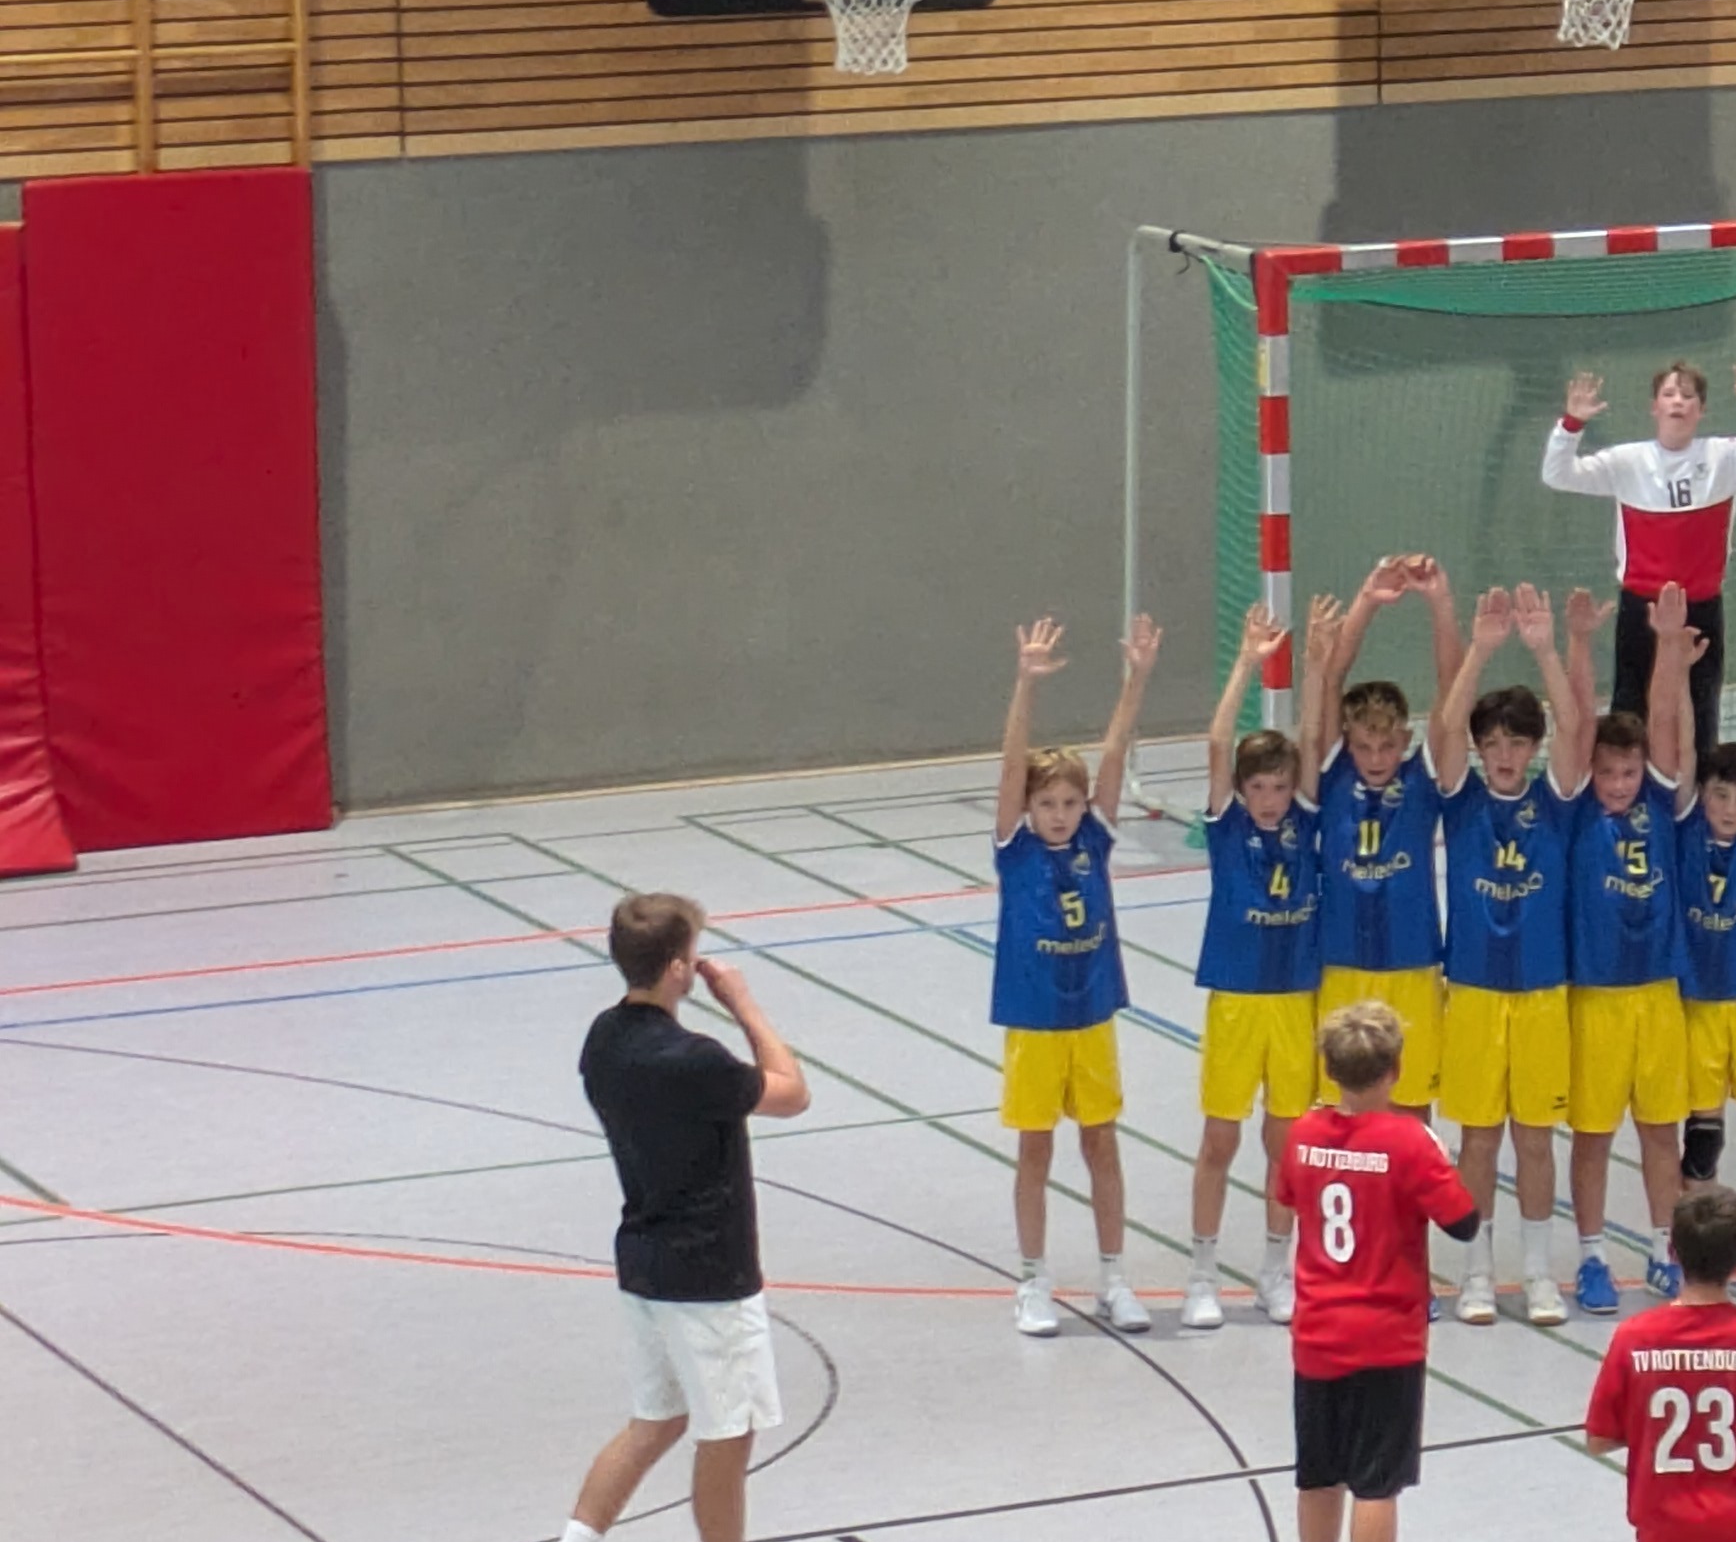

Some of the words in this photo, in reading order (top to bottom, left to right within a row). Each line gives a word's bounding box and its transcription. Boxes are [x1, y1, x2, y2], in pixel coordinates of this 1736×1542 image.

[1667, 478, 1692, 508] 16
[1359, 820, 1380, 856] 11
[1497, 840, 1527, 871] 14
[1616, 841, 1648, 874] 15
[1269, 862, 1290, 900] 4
[1708, 873, 1727, 905] 7
[1061, 891, 1086, 928] 5
[1321, 1182, 1356, 1263] 8
